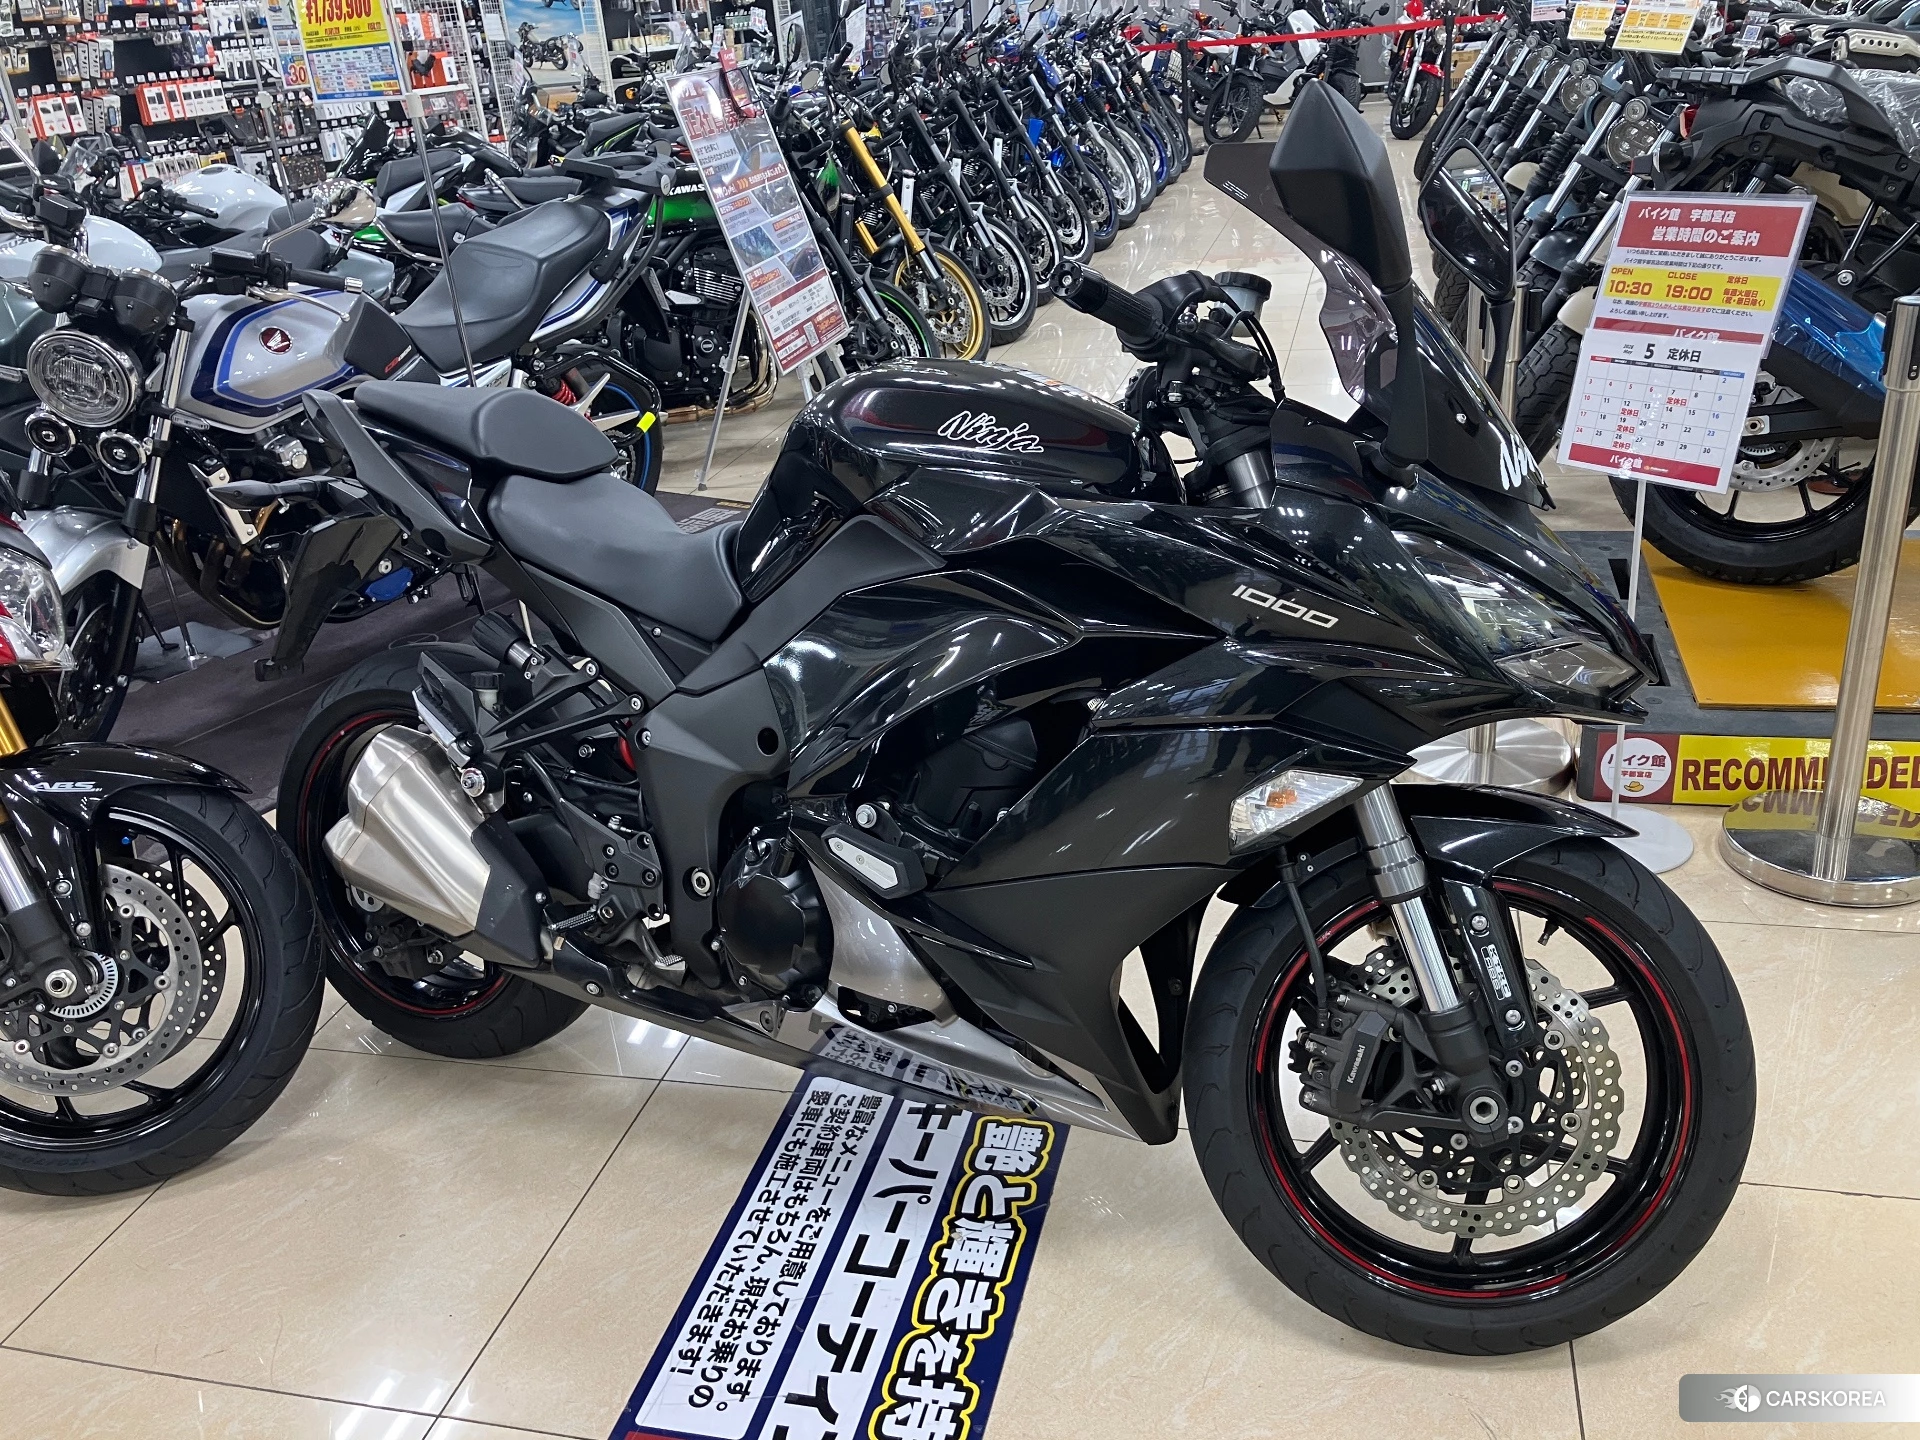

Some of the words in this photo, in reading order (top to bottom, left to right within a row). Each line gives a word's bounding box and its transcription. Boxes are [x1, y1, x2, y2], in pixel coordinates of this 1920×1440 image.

[1638, 206, 1681, 221] バイク館
[1690, 209, 1737, 224] 宇都宮店
[1651, 225, 1761, 247] 営業時間のご案内
[1611, 267, 1634, 276] OPEN
[1668, 271, 1698, 281] CLOSE
[1727, 275, 1749, 285] 定休日
[1608, 279, 1653, 296] 10:30
[1665, 284, 1713, 301] 19:00
[1644, 343, 1656, 360] 5
[1667, 348, 1702, 363] 定休日
[1666, 397, 1688, 407] 定休日
[1620, 407, 1639, 417] 定休日
[1712, 412, 1720, 420] 16
[937, 410, 1044, 453] Ninja
[1616, 424, 1635, 434] 定休日
[1612, 441, 1631, 450] 定休日
[1231, 584, 1339, 629] 1000
[33, 781, 97, 791] ABS
[1347, 1044, 1366, 1084] Kawasaki
[688, 1092, 857, 1411] ご契約車両はもちろん、現在お乗りの
[715, 1094, 884, 1412] 豊富なメニューをご用意しております。
